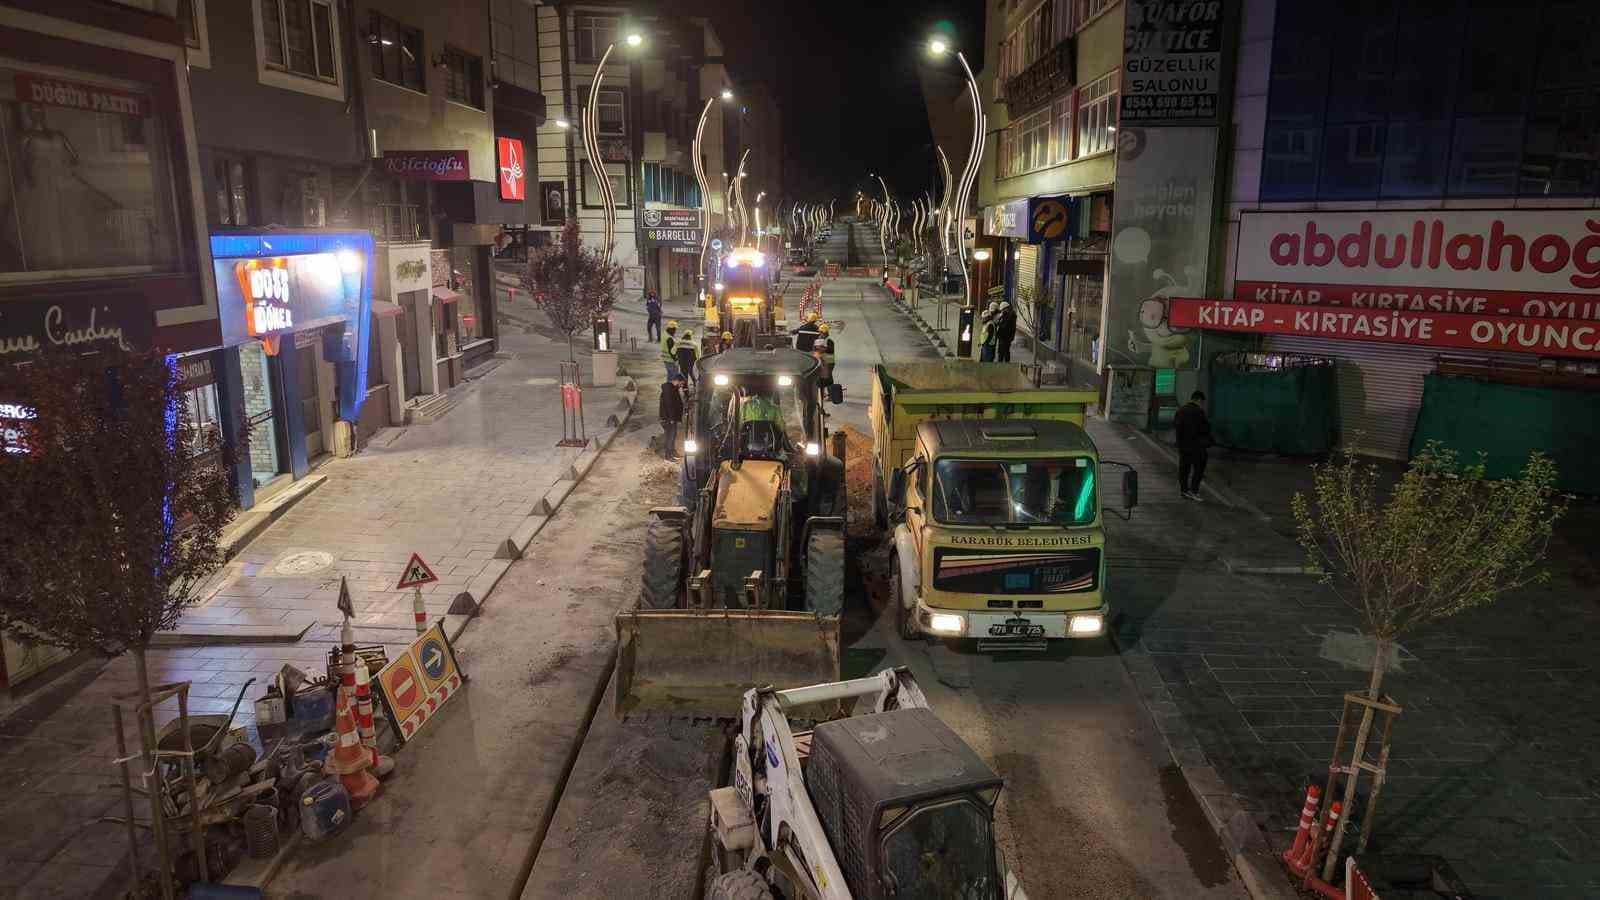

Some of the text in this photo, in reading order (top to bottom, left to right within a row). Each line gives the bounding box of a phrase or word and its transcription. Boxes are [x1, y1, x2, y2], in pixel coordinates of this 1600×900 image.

[1126, 55, 1217, 73] GÜZELLİK
[1132, 78, 1209, 93] SALONU
[656, 230, 697, 241] BARGELLO
[1199, 301, 1265, 328] KİTAP
[1294, 310, 1433, 340] KIRTASİYE
[1470, 320, 1600, 352] OYUNC
